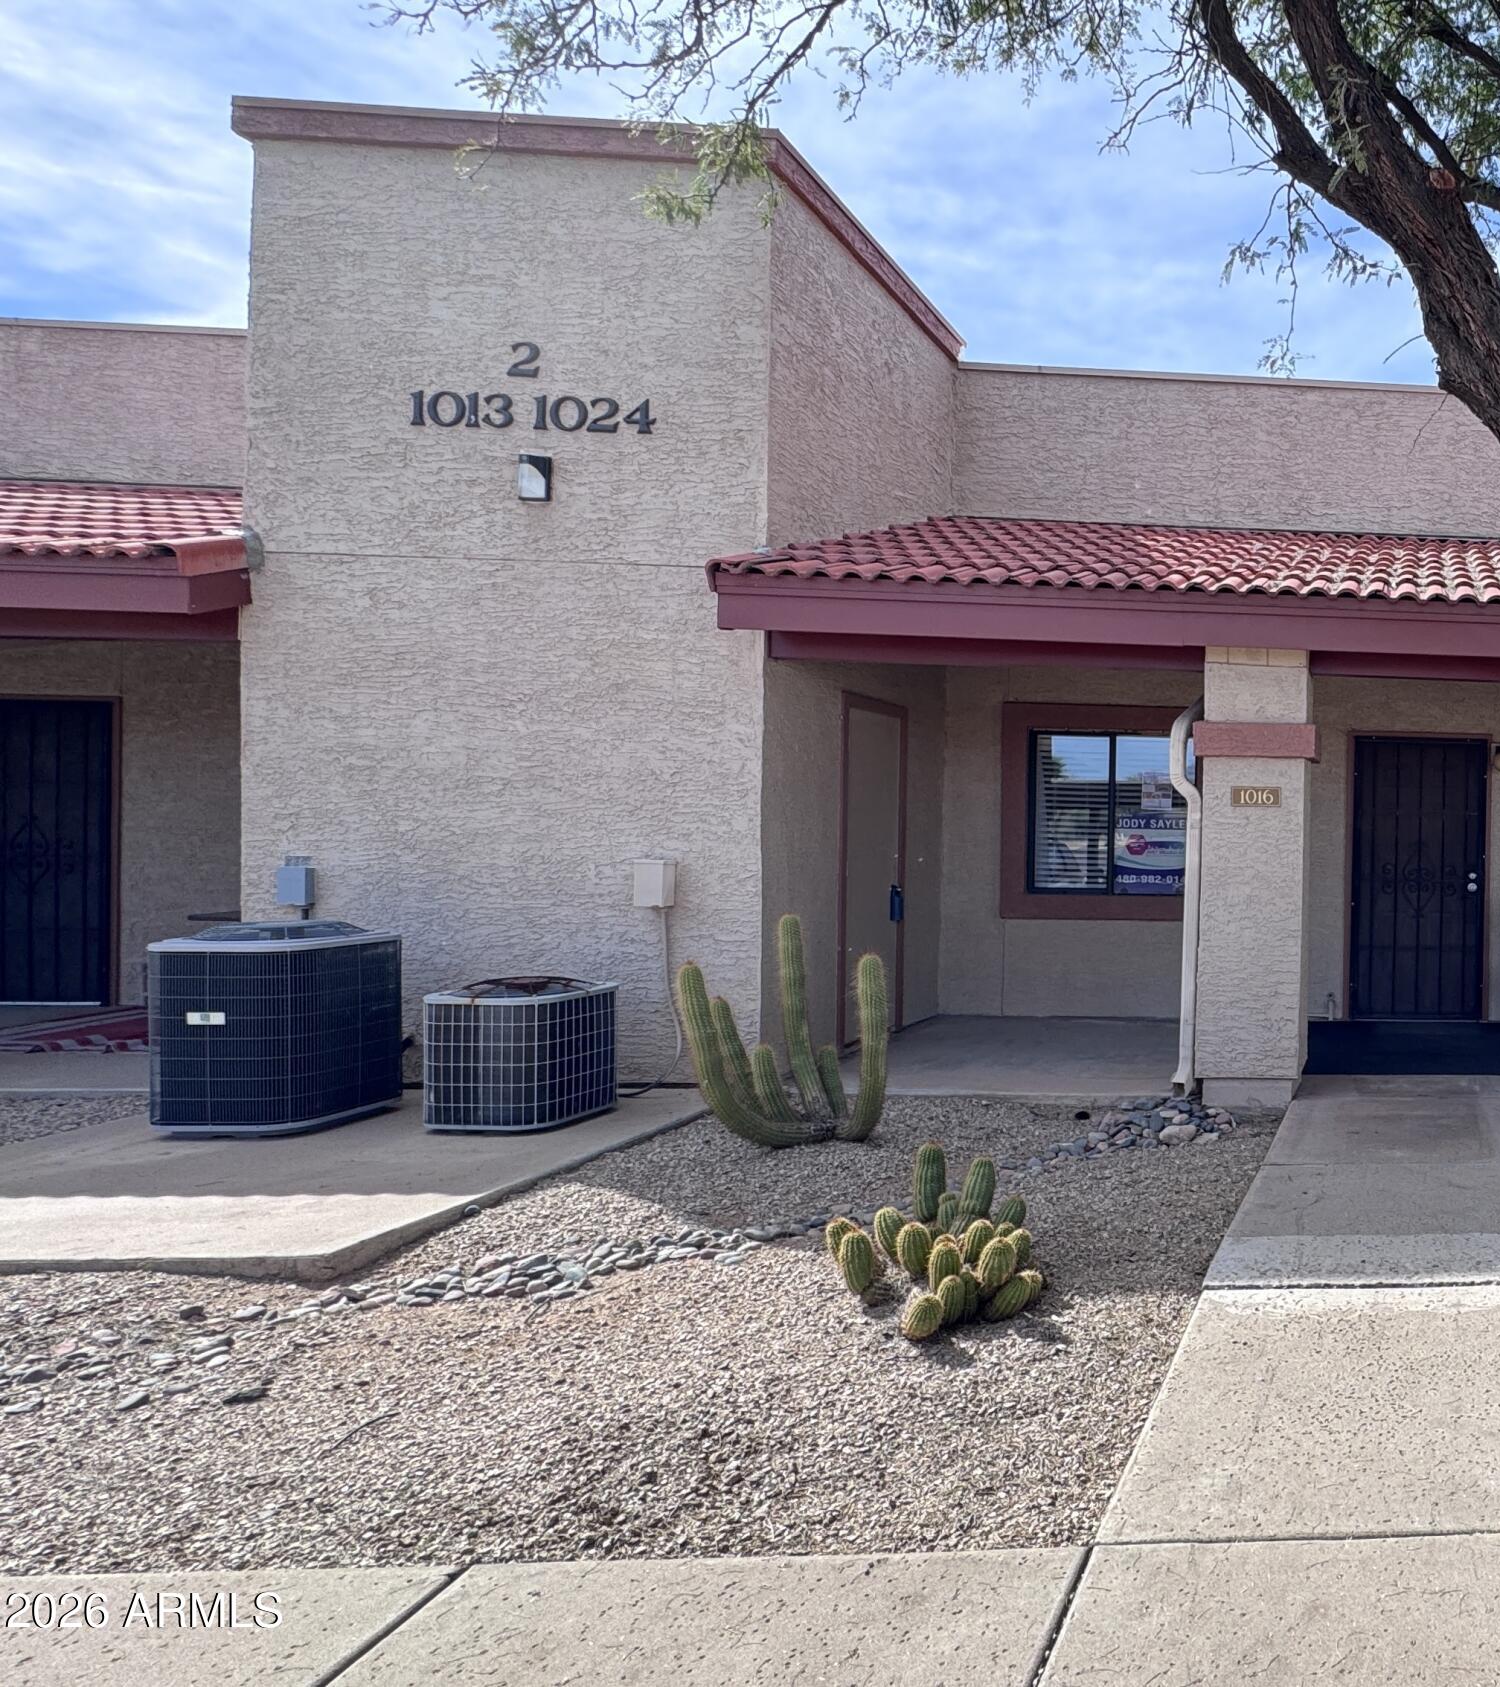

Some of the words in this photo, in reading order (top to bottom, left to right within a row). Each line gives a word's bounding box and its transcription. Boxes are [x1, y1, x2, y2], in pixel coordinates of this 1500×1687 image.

[506, 341, 541, 378] 2
[410, 389, 514, 429] 1013
[533, 394, 657, 435] 1024
[1239, 789, 1274, 805] 1016
[1116, 818, 1146, 829] JODY
